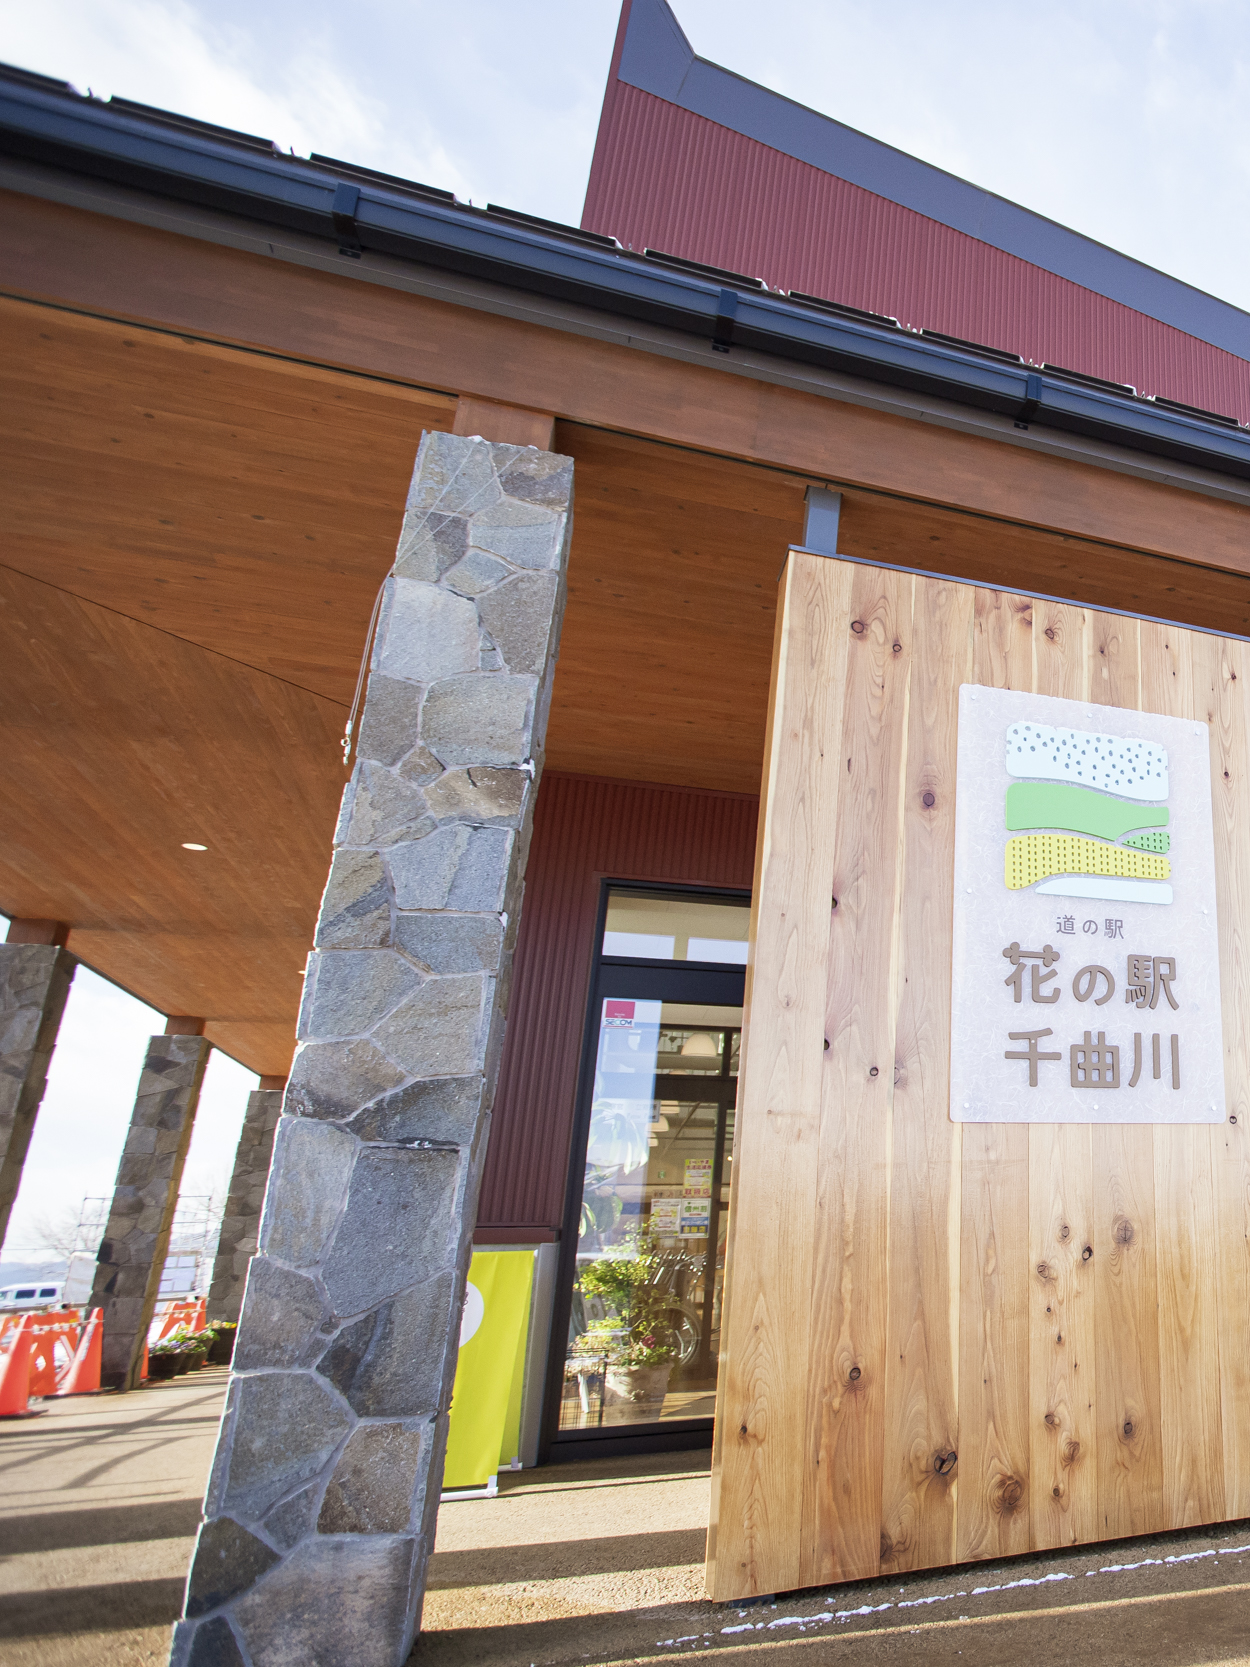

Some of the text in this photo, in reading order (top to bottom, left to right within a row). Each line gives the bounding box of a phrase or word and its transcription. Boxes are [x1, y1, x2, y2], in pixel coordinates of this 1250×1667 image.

[1056, 915, 1125, 940] 道の駅
[1002, 942, 1180, 1011] 花の駅
[605, 1018, 632, 1026] SECOM
[1004, 1027, 1181, 1090] 千曲川
